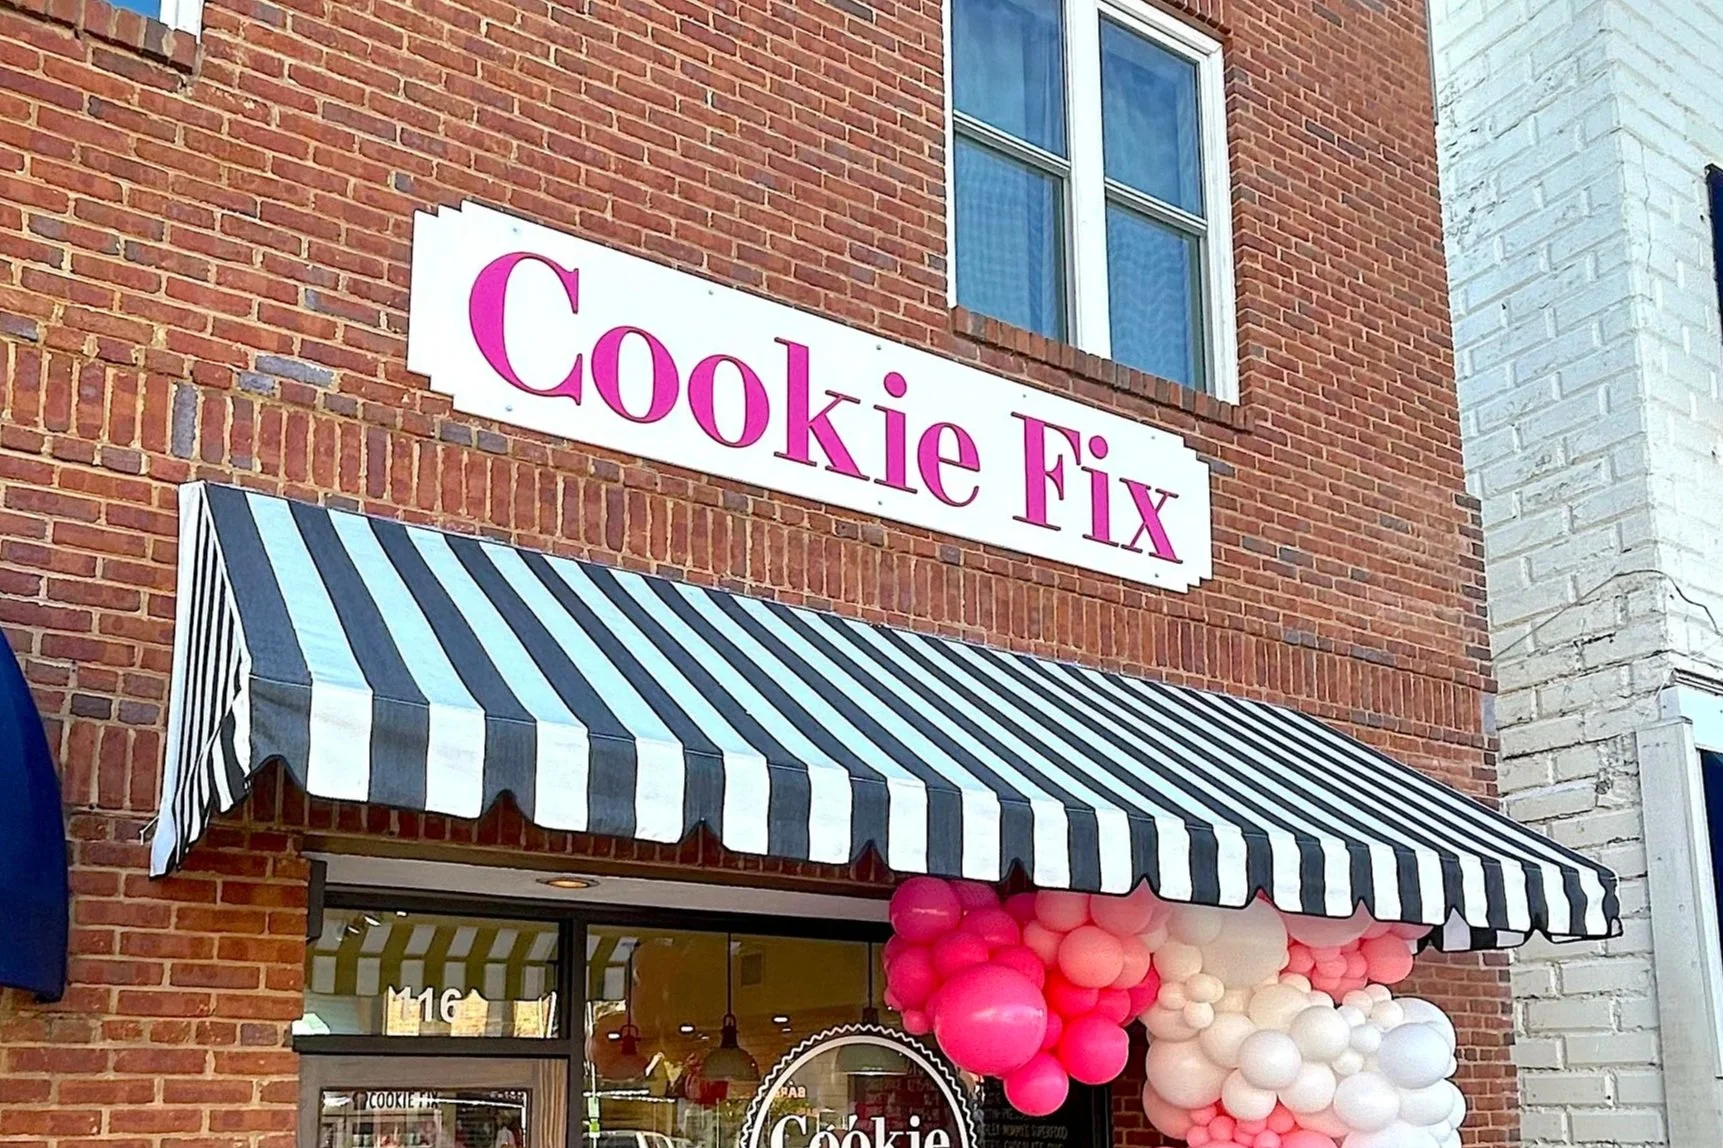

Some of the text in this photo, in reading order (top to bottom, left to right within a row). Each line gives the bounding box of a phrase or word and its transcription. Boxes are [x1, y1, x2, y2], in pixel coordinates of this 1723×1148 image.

[468, 251, 1184, 565] Cookie Fix
[396, 986, 463, 1024] 116
[369, 1092, 415, 1109] COOKIE
